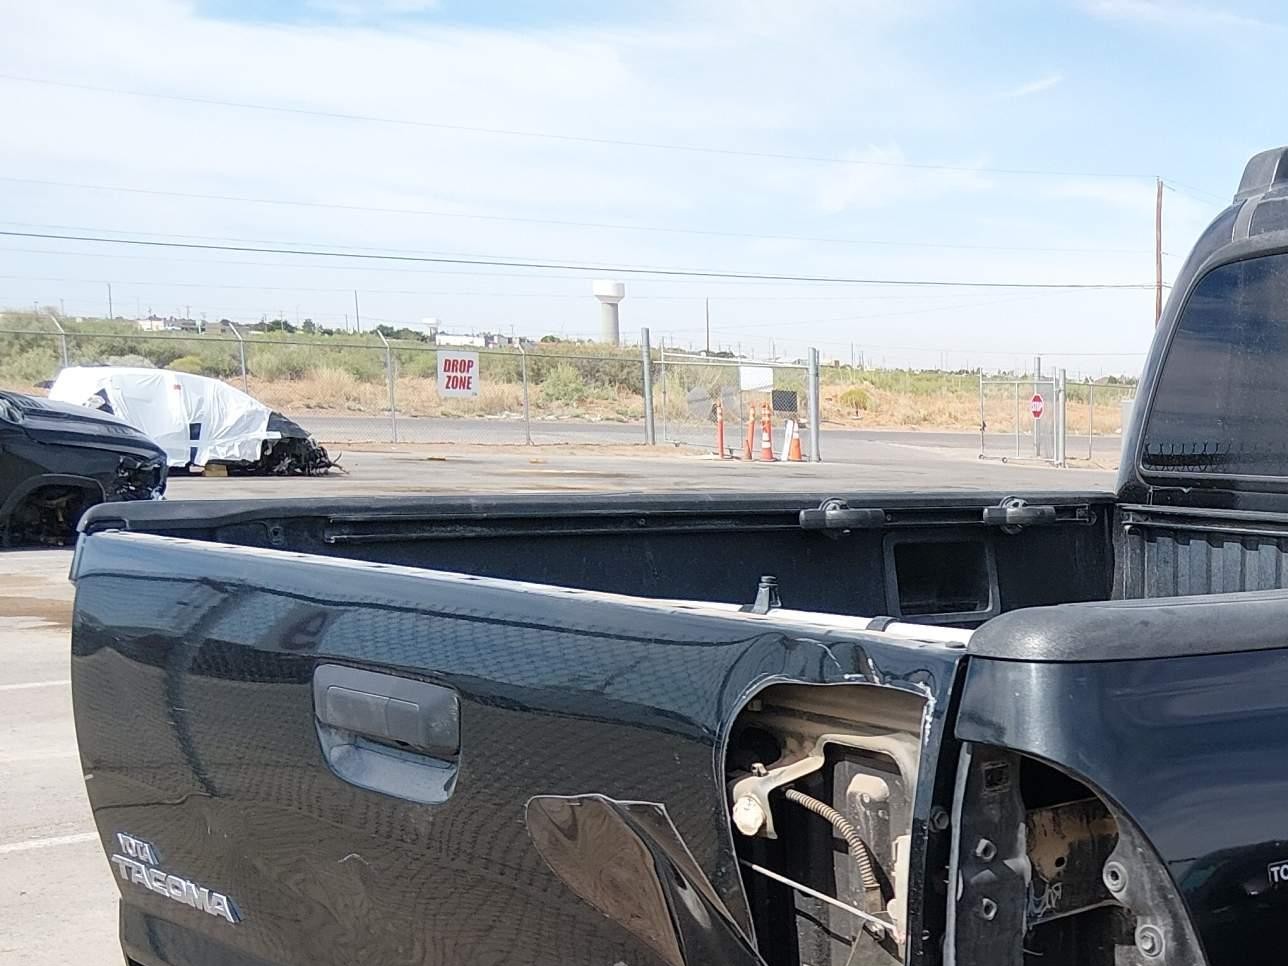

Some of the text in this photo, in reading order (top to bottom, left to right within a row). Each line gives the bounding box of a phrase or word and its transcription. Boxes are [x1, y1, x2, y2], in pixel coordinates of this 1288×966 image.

[443, 358, 474, 374] DROP
[445, 375, 472, 390] ZONE
[111, 853, 242, 925] TACOMA
